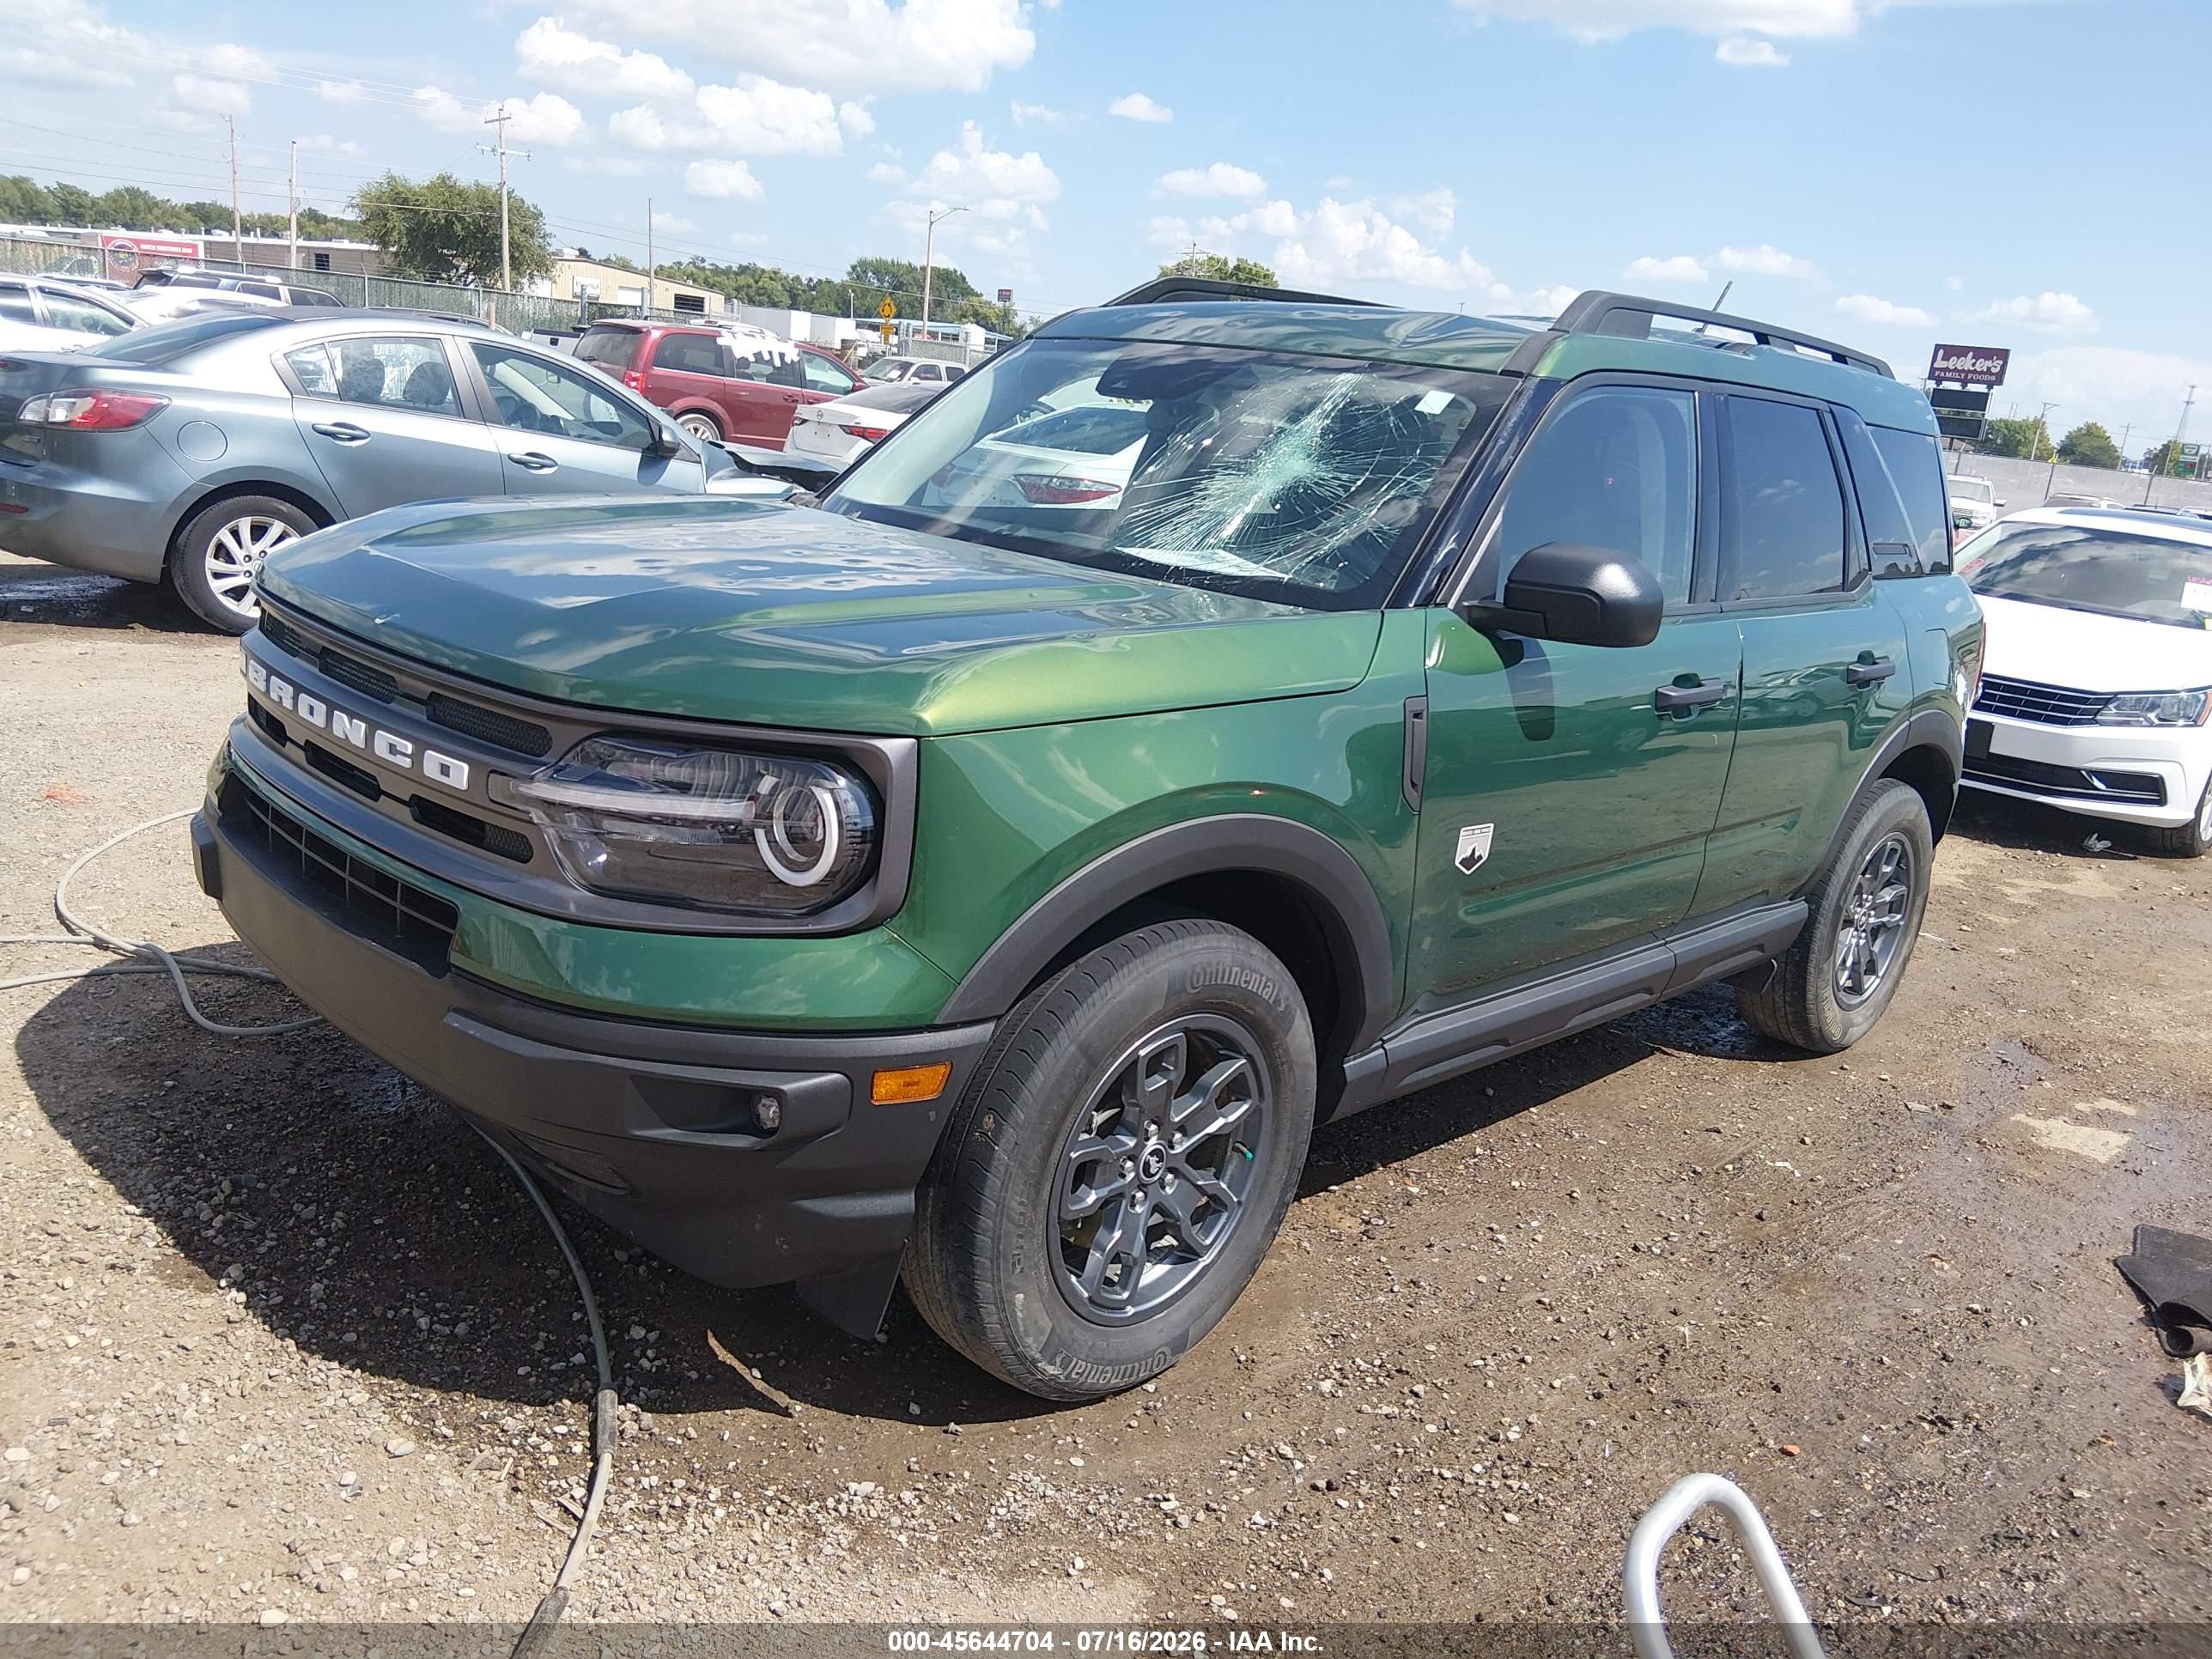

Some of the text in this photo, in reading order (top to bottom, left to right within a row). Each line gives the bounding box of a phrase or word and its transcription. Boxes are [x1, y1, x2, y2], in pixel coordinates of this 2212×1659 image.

[1934, 349, 2002, 373] Leeker's
[247, 659, 469, 791] BRONCO
[1187, 965, 1278, 1005] Continental
[1062, 1346, 1172, 1384] Continental
